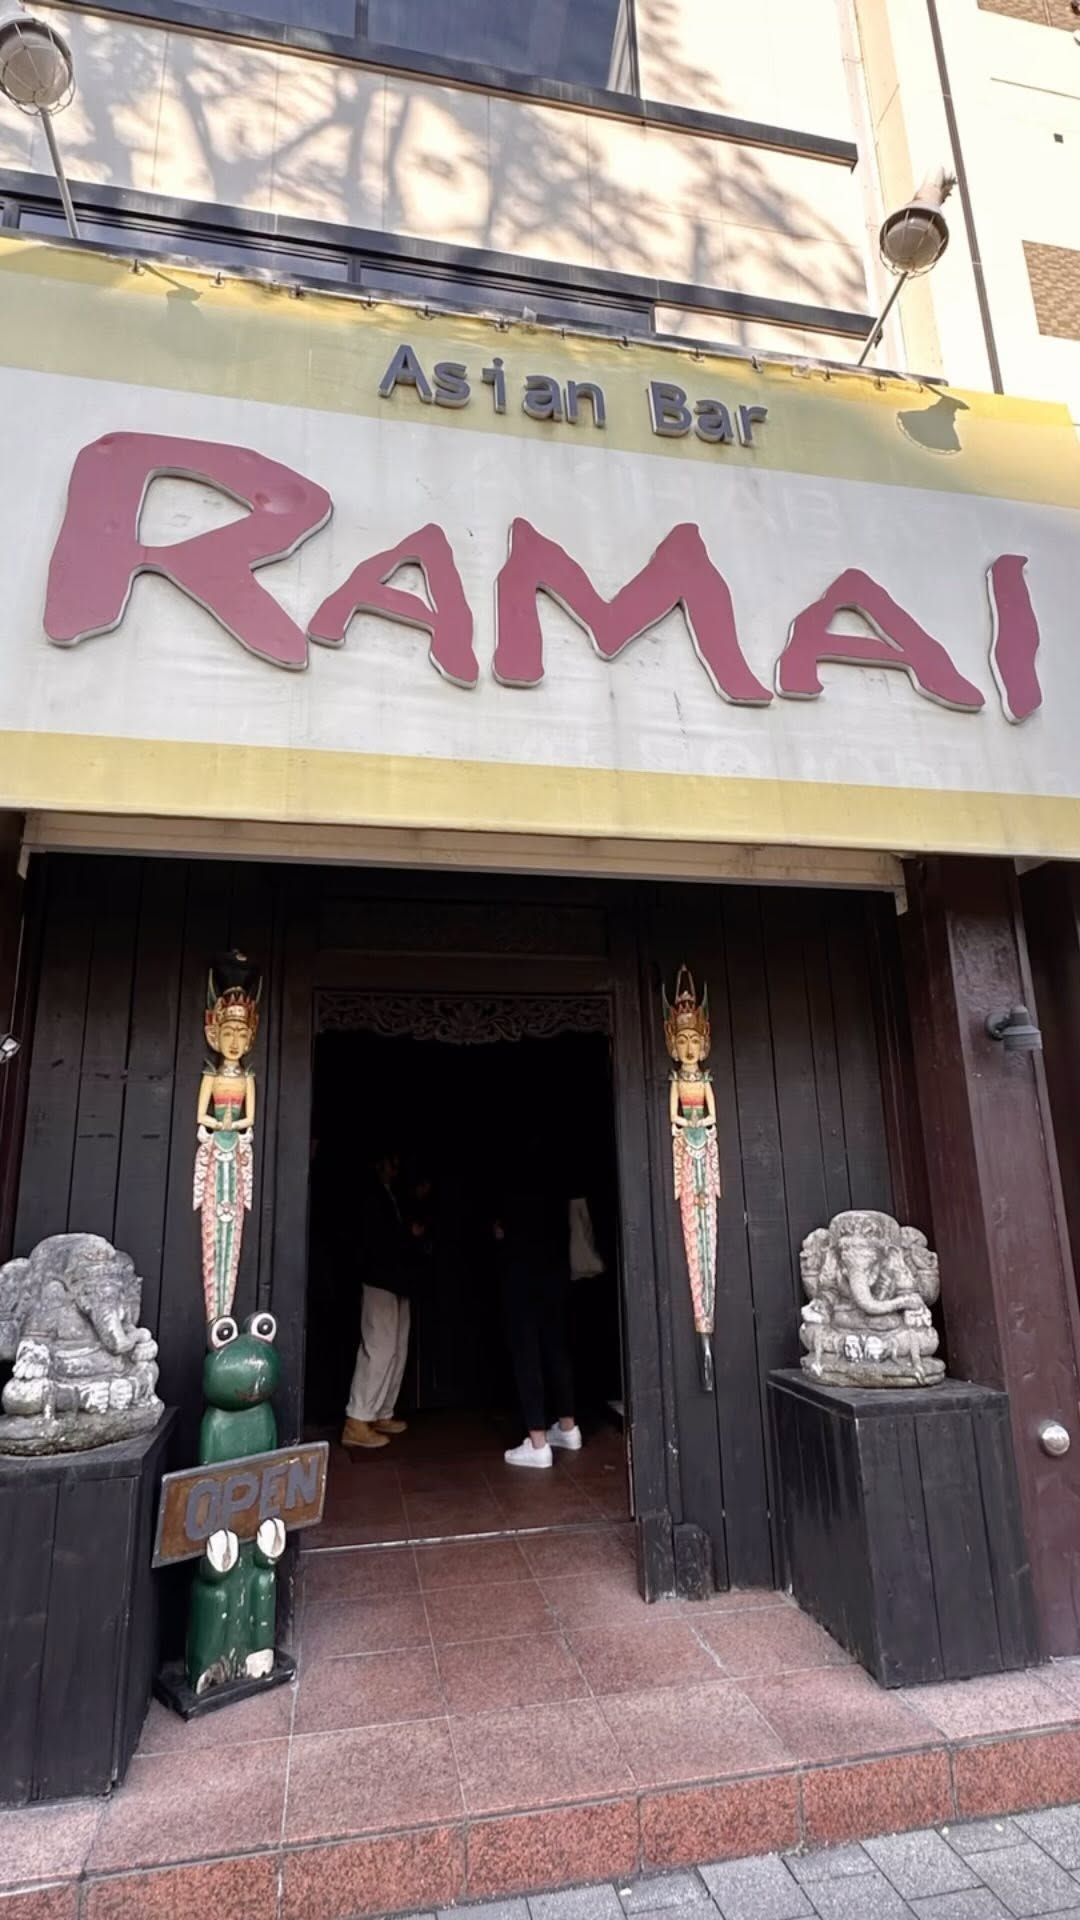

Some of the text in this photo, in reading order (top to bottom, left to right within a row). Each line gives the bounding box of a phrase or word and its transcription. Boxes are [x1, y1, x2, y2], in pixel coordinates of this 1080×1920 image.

[378, 343, 769, 447] Asian Bar
[43, 431, 1043, 724] RAMAI
[185, 1456, 318, 1540] OPEN
